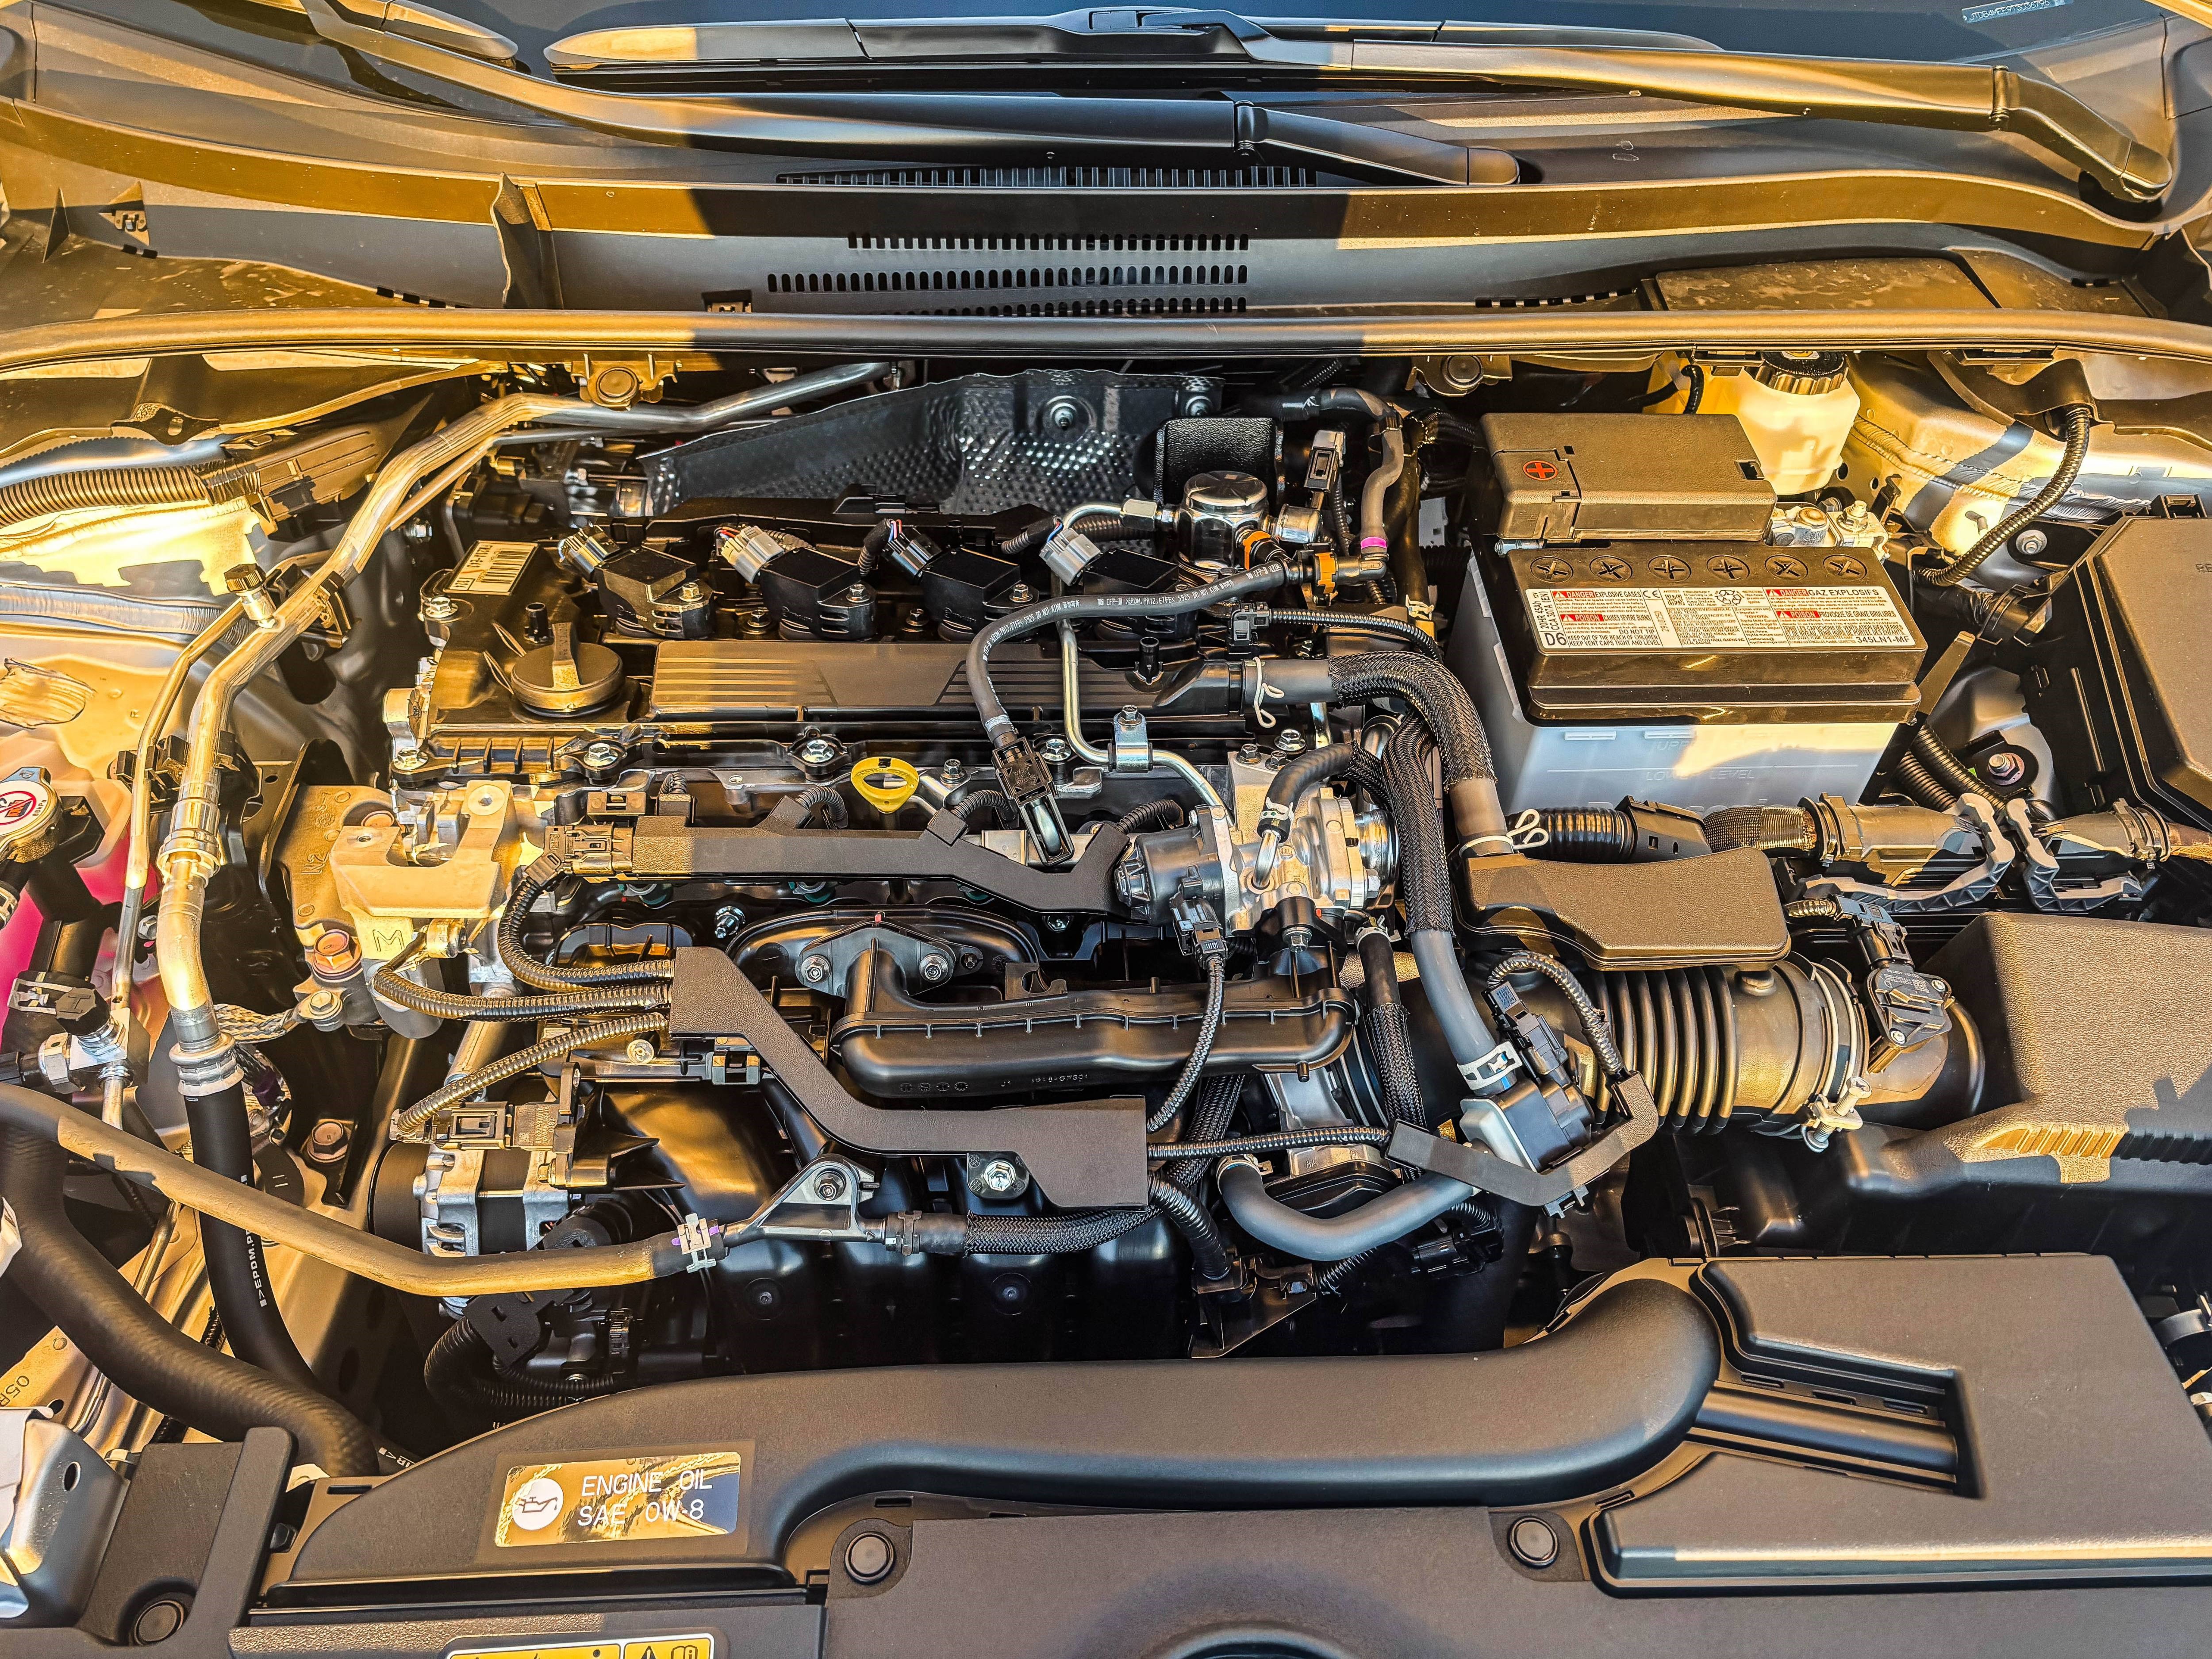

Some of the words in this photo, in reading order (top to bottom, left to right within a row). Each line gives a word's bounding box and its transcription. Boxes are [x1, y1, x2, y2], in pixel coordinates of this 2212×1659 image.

[1544, 632, 1567, 646] D6
[581, 1471, 664, 1496] ENGINE
[680, 1469, 713, 1490] OIL
[577, 1503, 627, 1527] SAE
